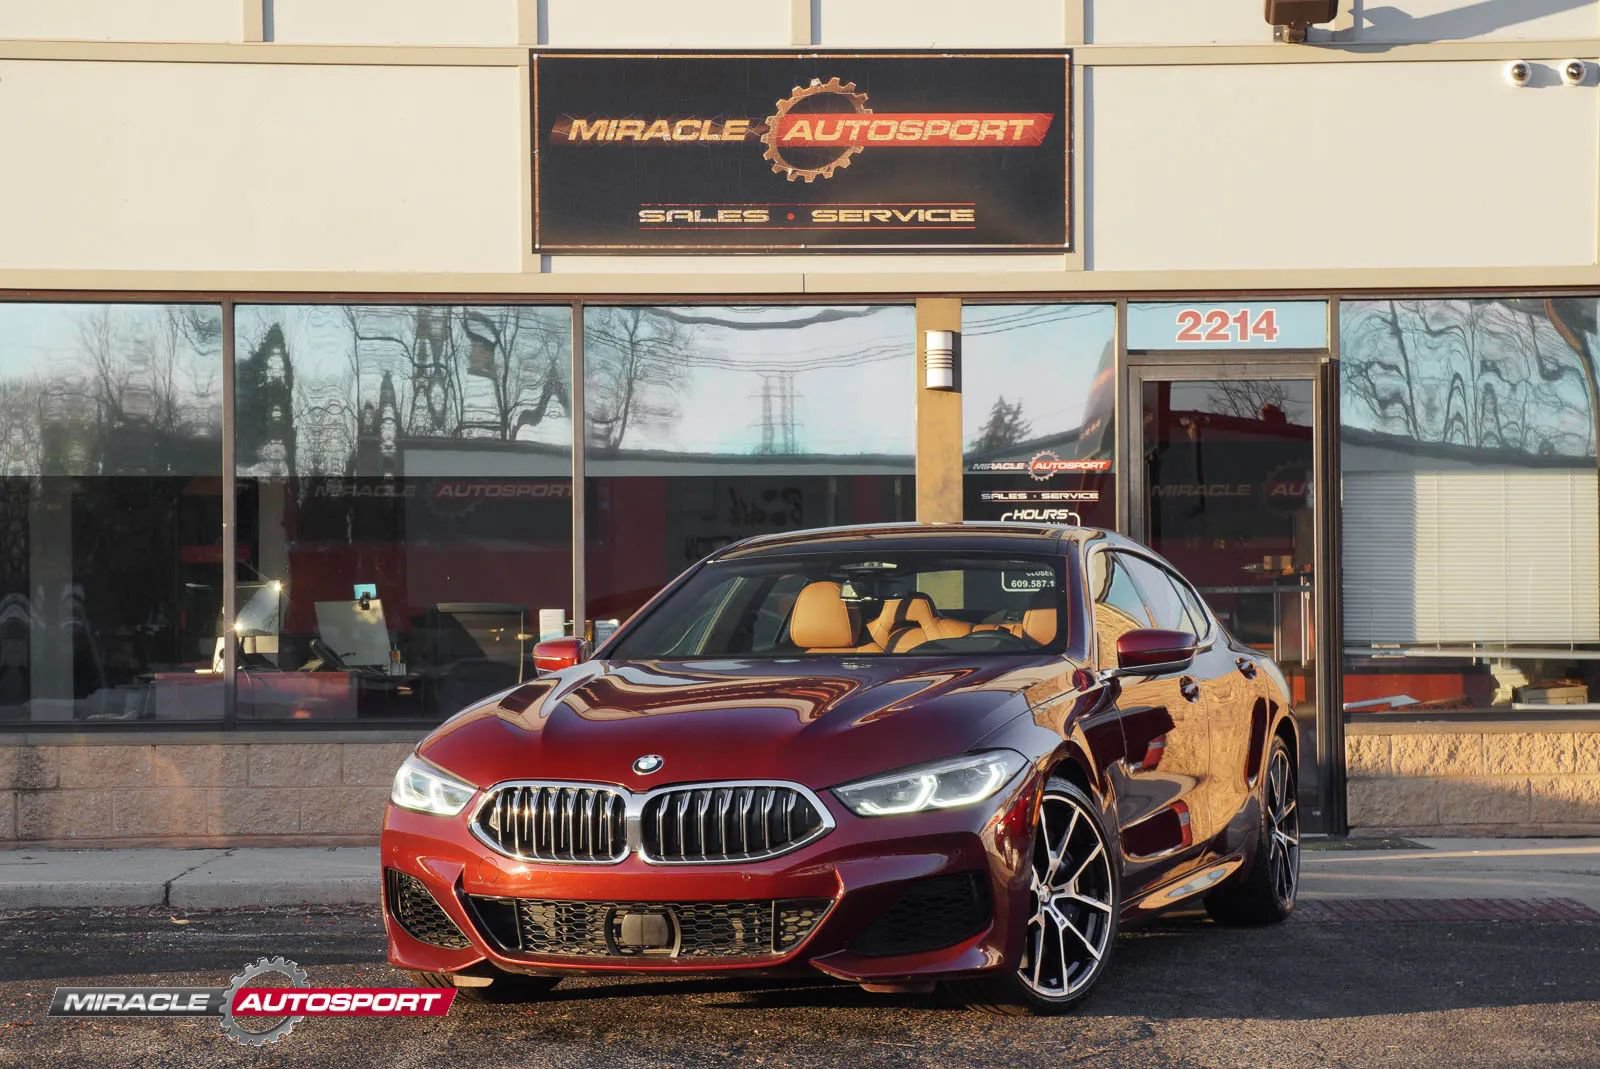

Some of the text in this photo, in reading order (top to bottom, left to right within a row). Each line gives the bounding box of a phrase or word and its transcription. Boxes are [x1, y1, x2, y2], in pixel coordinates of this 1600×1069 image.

[568, 119, 1035, 142] MIRACLE AUTOSPORT
[638, 209, 976, 223] SALES SERVICE
[1176, 309, 1279, 343] 2214
[973, 461, 1106, 471] MIRACLE AUTOSPORT
[981, 492, 1099, 500] SALES SERVICE
[1013, 509, 1069, 520] HOURS
